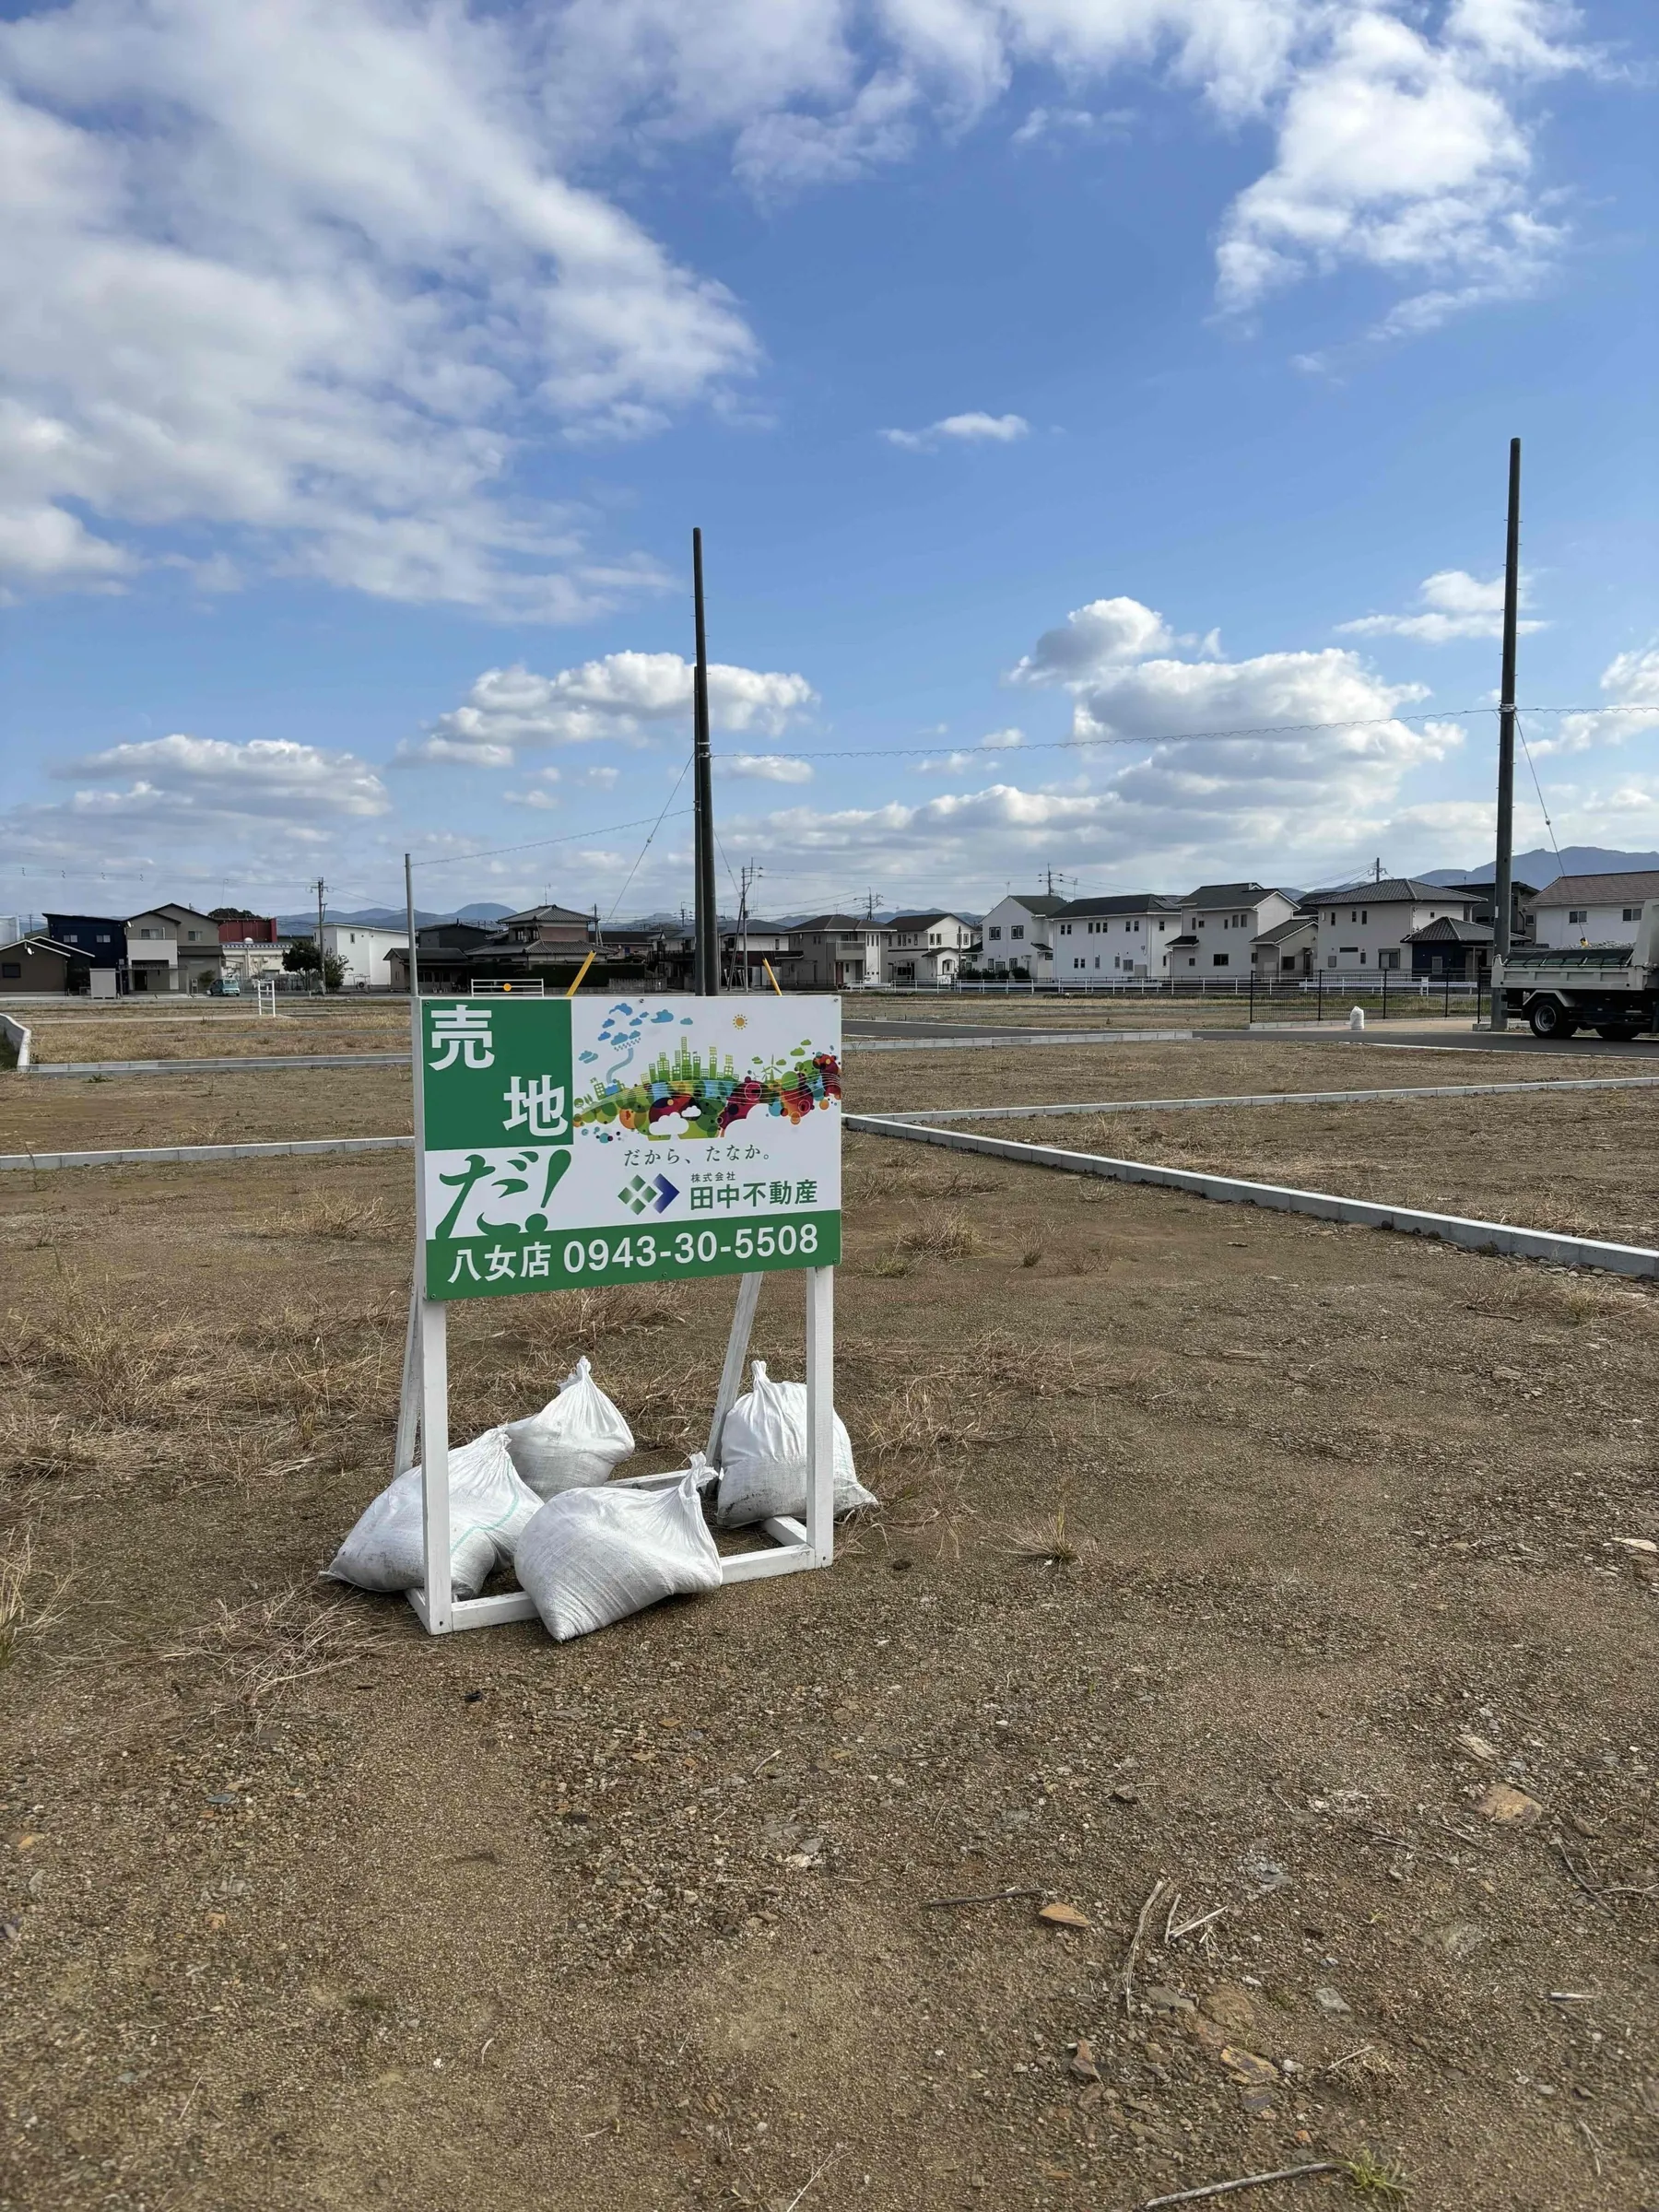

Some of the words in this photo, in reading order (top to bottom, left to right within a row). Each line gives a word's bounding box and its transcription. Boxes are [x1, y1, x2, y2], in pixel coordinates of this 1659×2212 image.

[690, 1171, 736, 1182] 株式会社
[690, 1179, 818, 1211] 田中不動産
[447, 1242, 551, 1284] 八女店
[563, 1223, 818, 1274] 0943-30-5508
